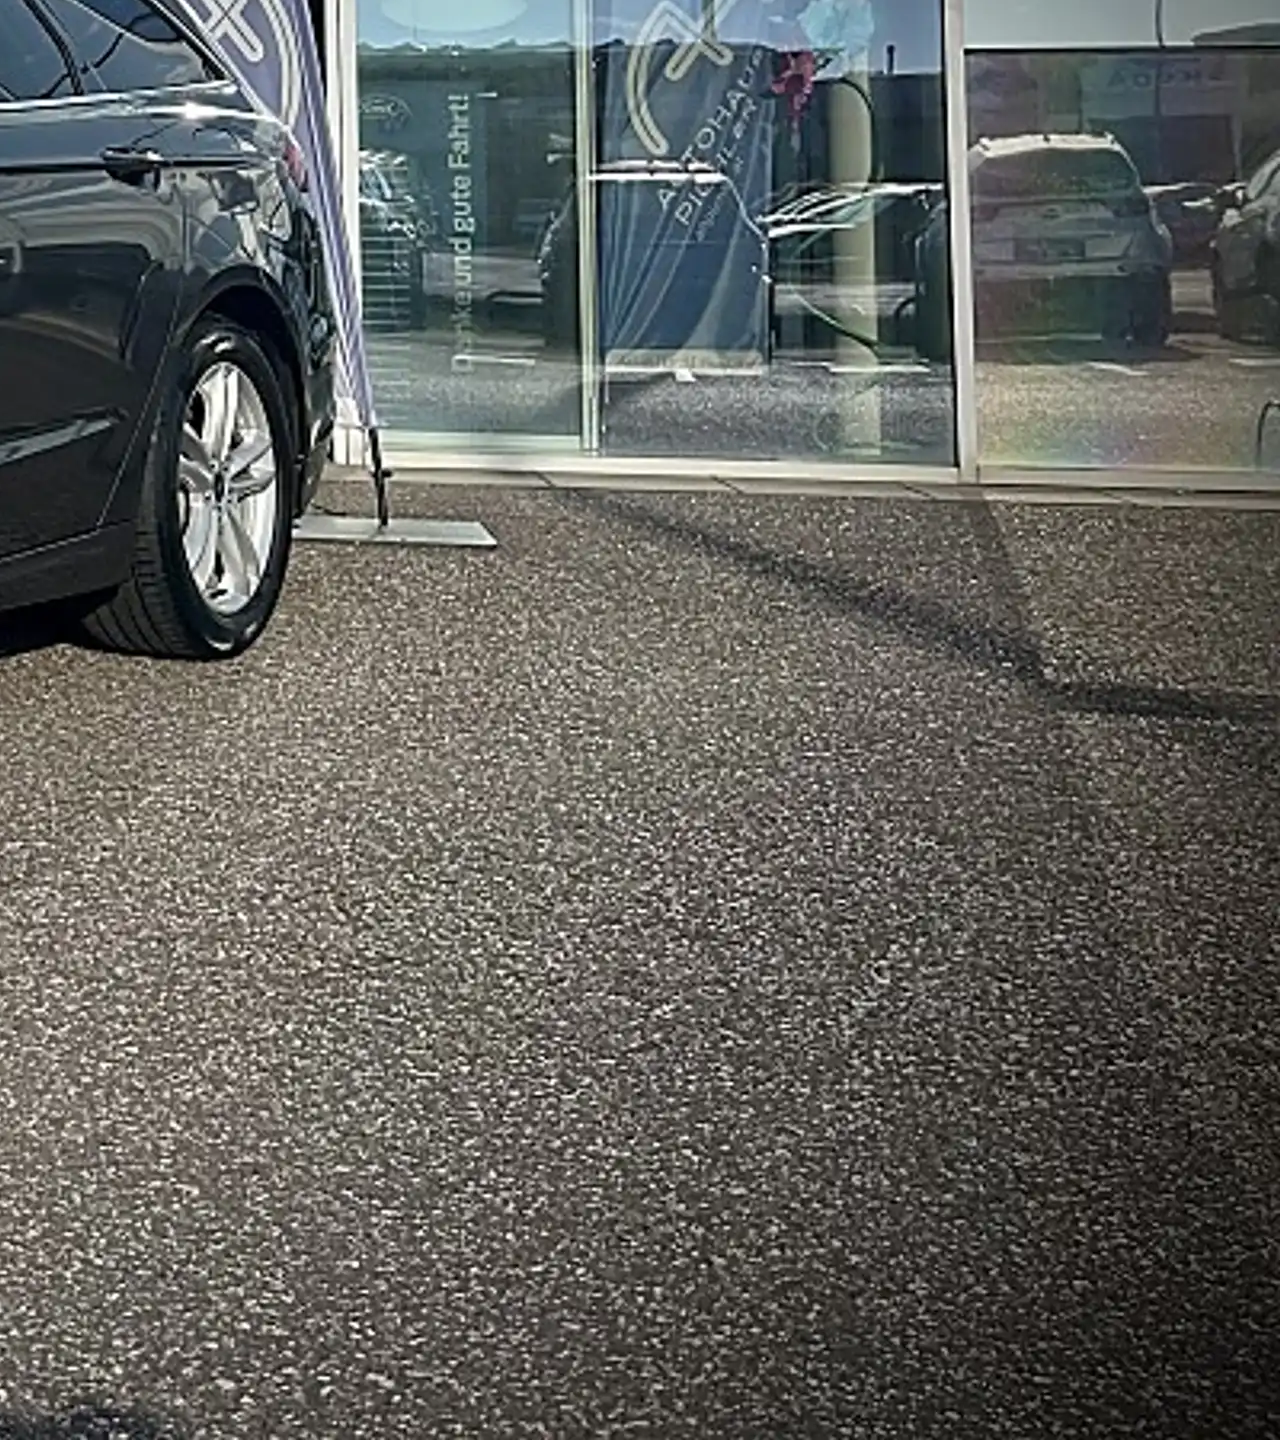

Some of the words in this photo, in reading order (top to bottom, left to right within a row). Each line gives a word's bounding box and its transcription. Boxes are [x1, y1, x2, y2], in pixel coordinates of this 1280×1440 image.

[447, 92, 473, 169] Fahrt!
[449, 175, 476, 233] gute
[449, 237, 473, 286] und
